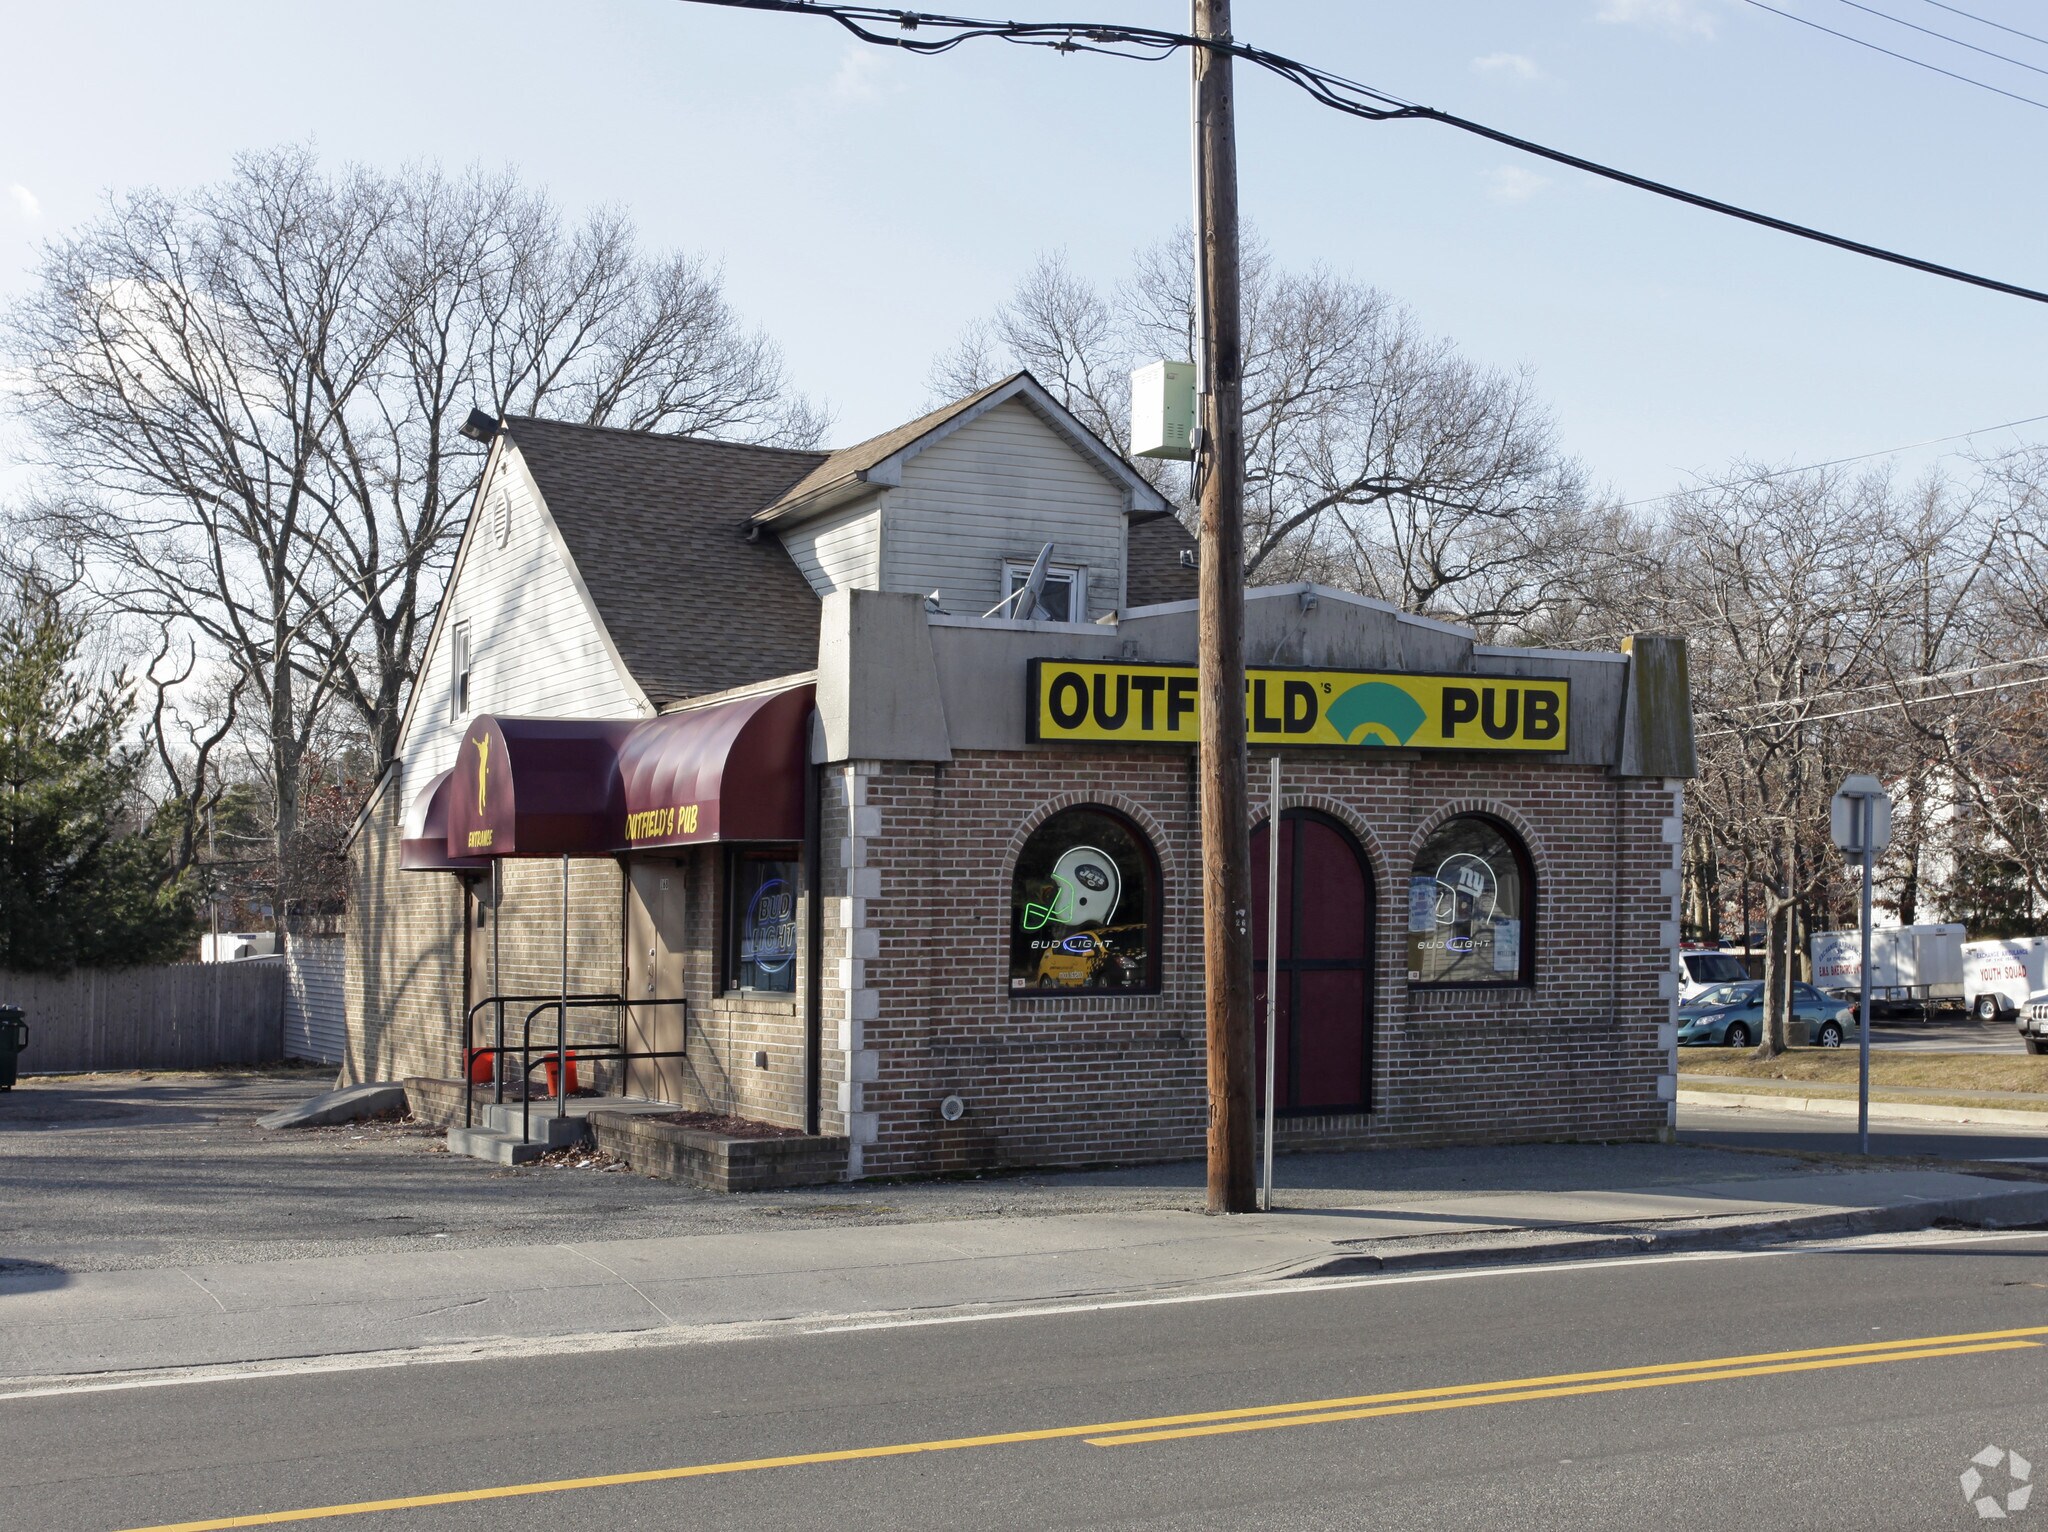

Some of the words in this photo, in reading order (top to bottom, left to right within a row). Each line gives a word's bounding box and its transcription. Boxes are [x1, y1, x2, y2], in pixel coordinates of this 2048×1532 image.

[1049, 672, 1331, 733] OUTFLD'S
[1442, 687, 1560, 740] PUB
[625, 807, 675, 841] OUTFIELD'S
[677, 804, 698, 835] PUB
[468, 829, 493, 848] ENTRANCE
[759, 893, 791, 922] BUD
[751, 923, 796, 952] LIGHT
[1031, 940, 1060, 949] BUD
[1069, 940, 1113, 948] LIGHT
[1417, 941, 1444, 949] BUD
[1452, 940, 1490, 948] LIGHT
[1980, 967, 2001, 981] YOUTH
[2004, 965, 2027, 979] SQUAD
